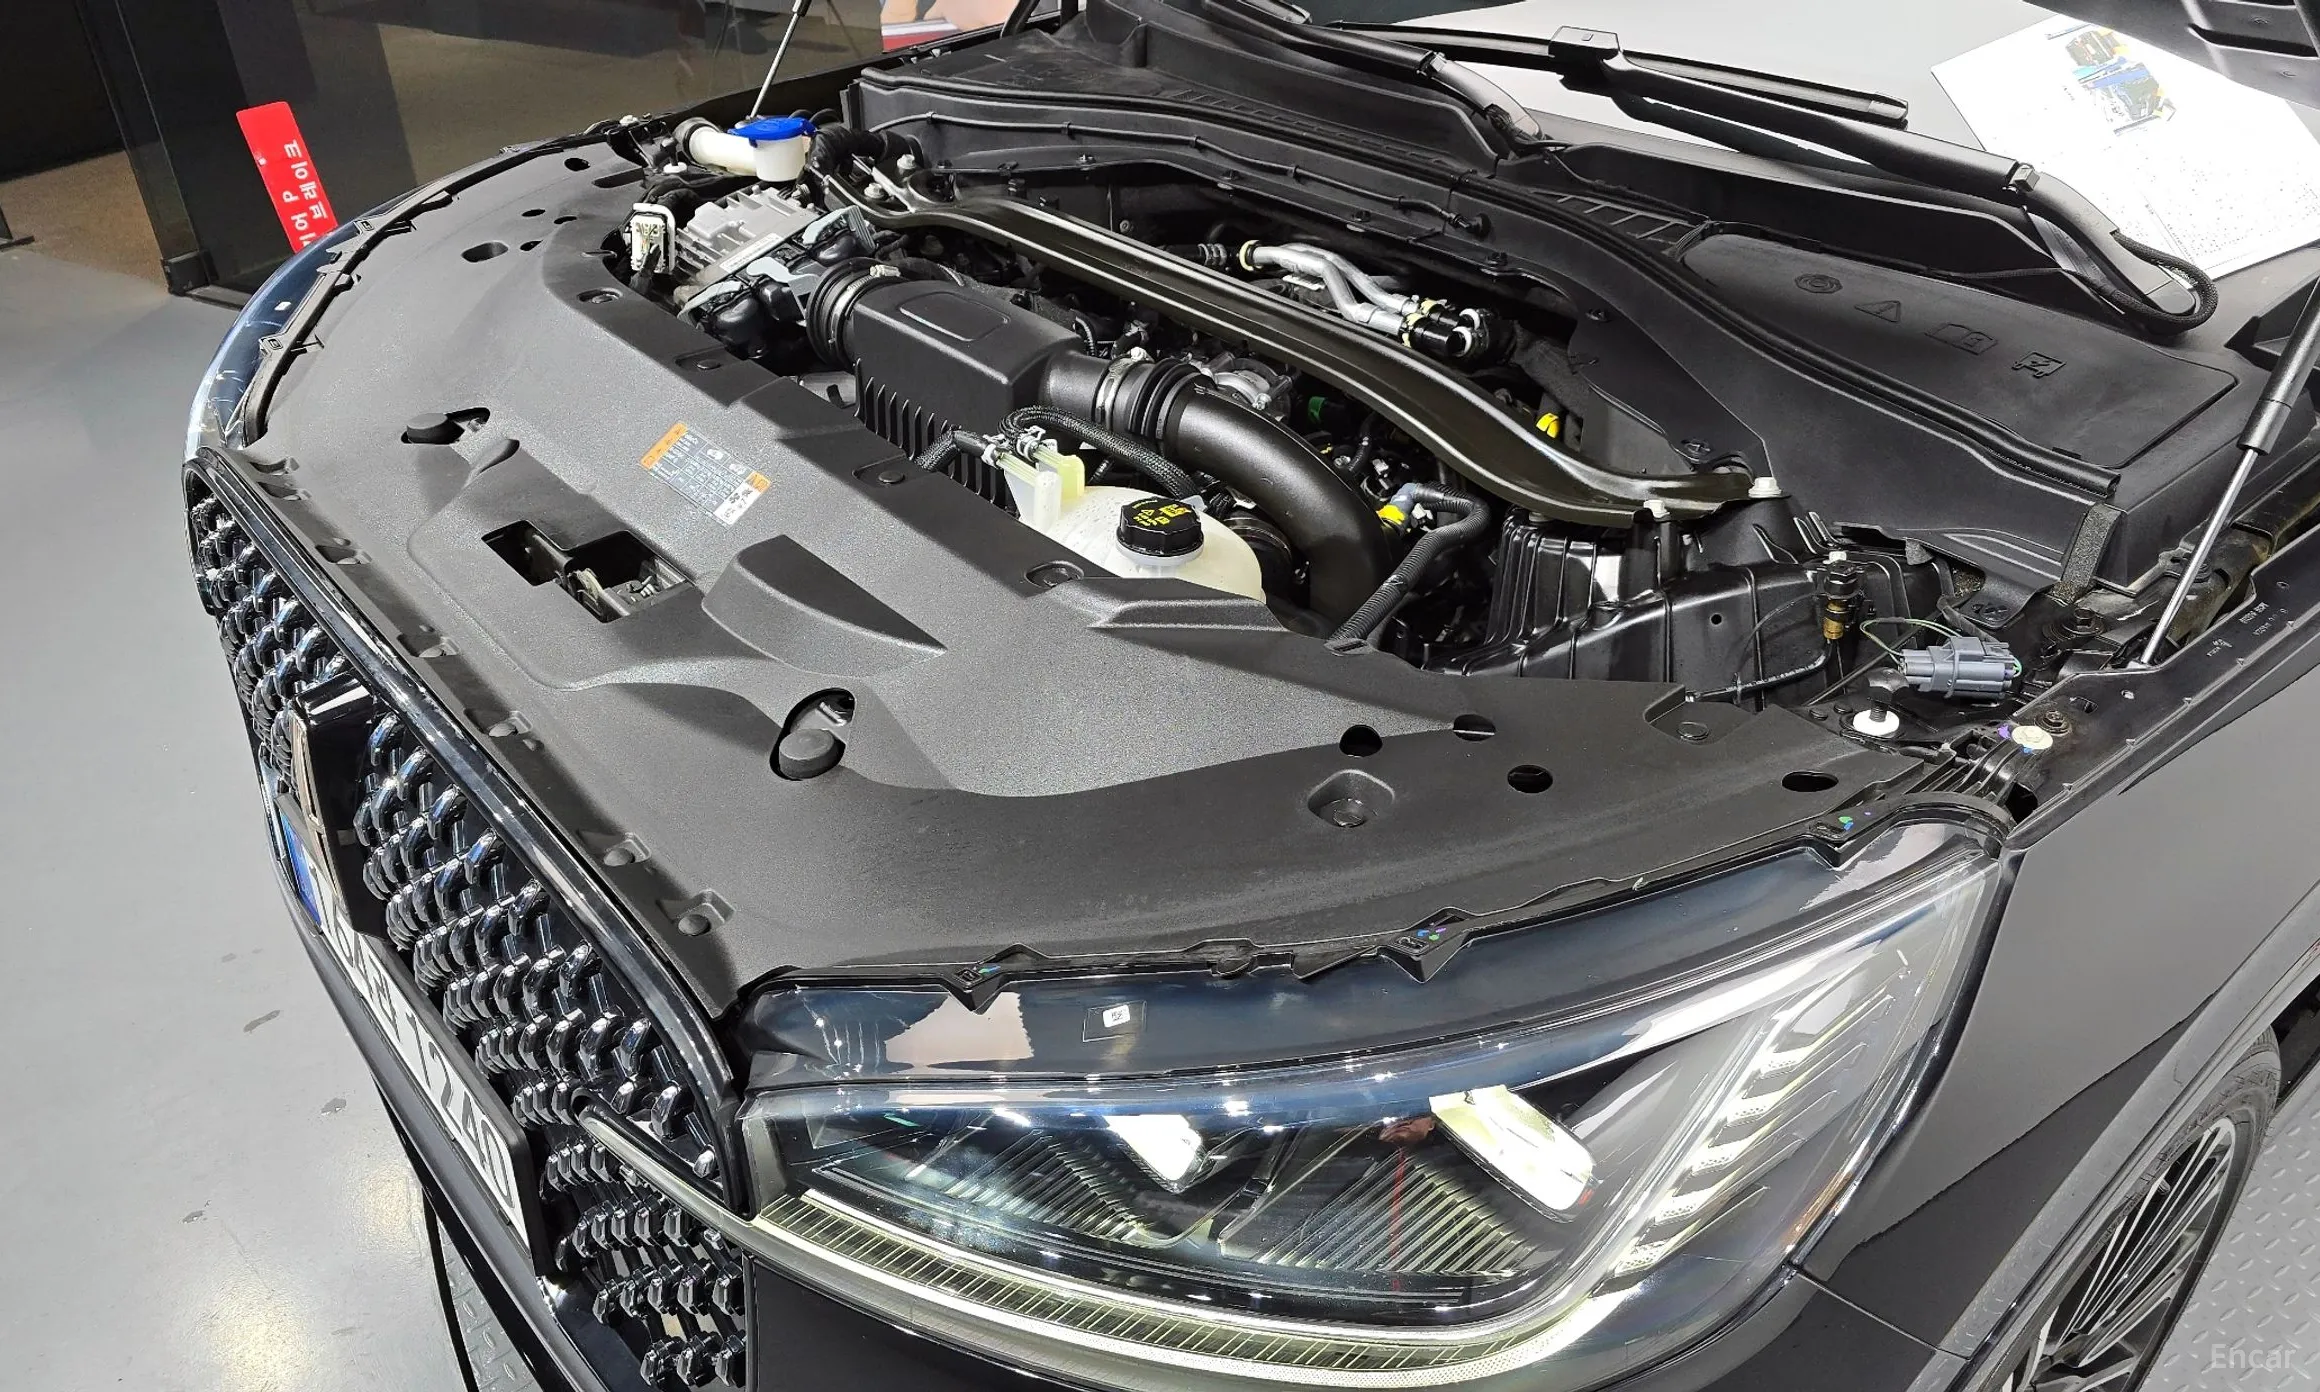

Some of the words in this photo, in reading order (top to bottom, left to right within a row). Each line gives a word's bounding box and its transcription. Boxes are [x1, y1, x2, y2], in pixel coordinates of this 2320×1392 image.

[283, 191, 299, 203] P
[284, 139, 328, 219] 브레이크
[405, 1011, 515, 1208] 1240
